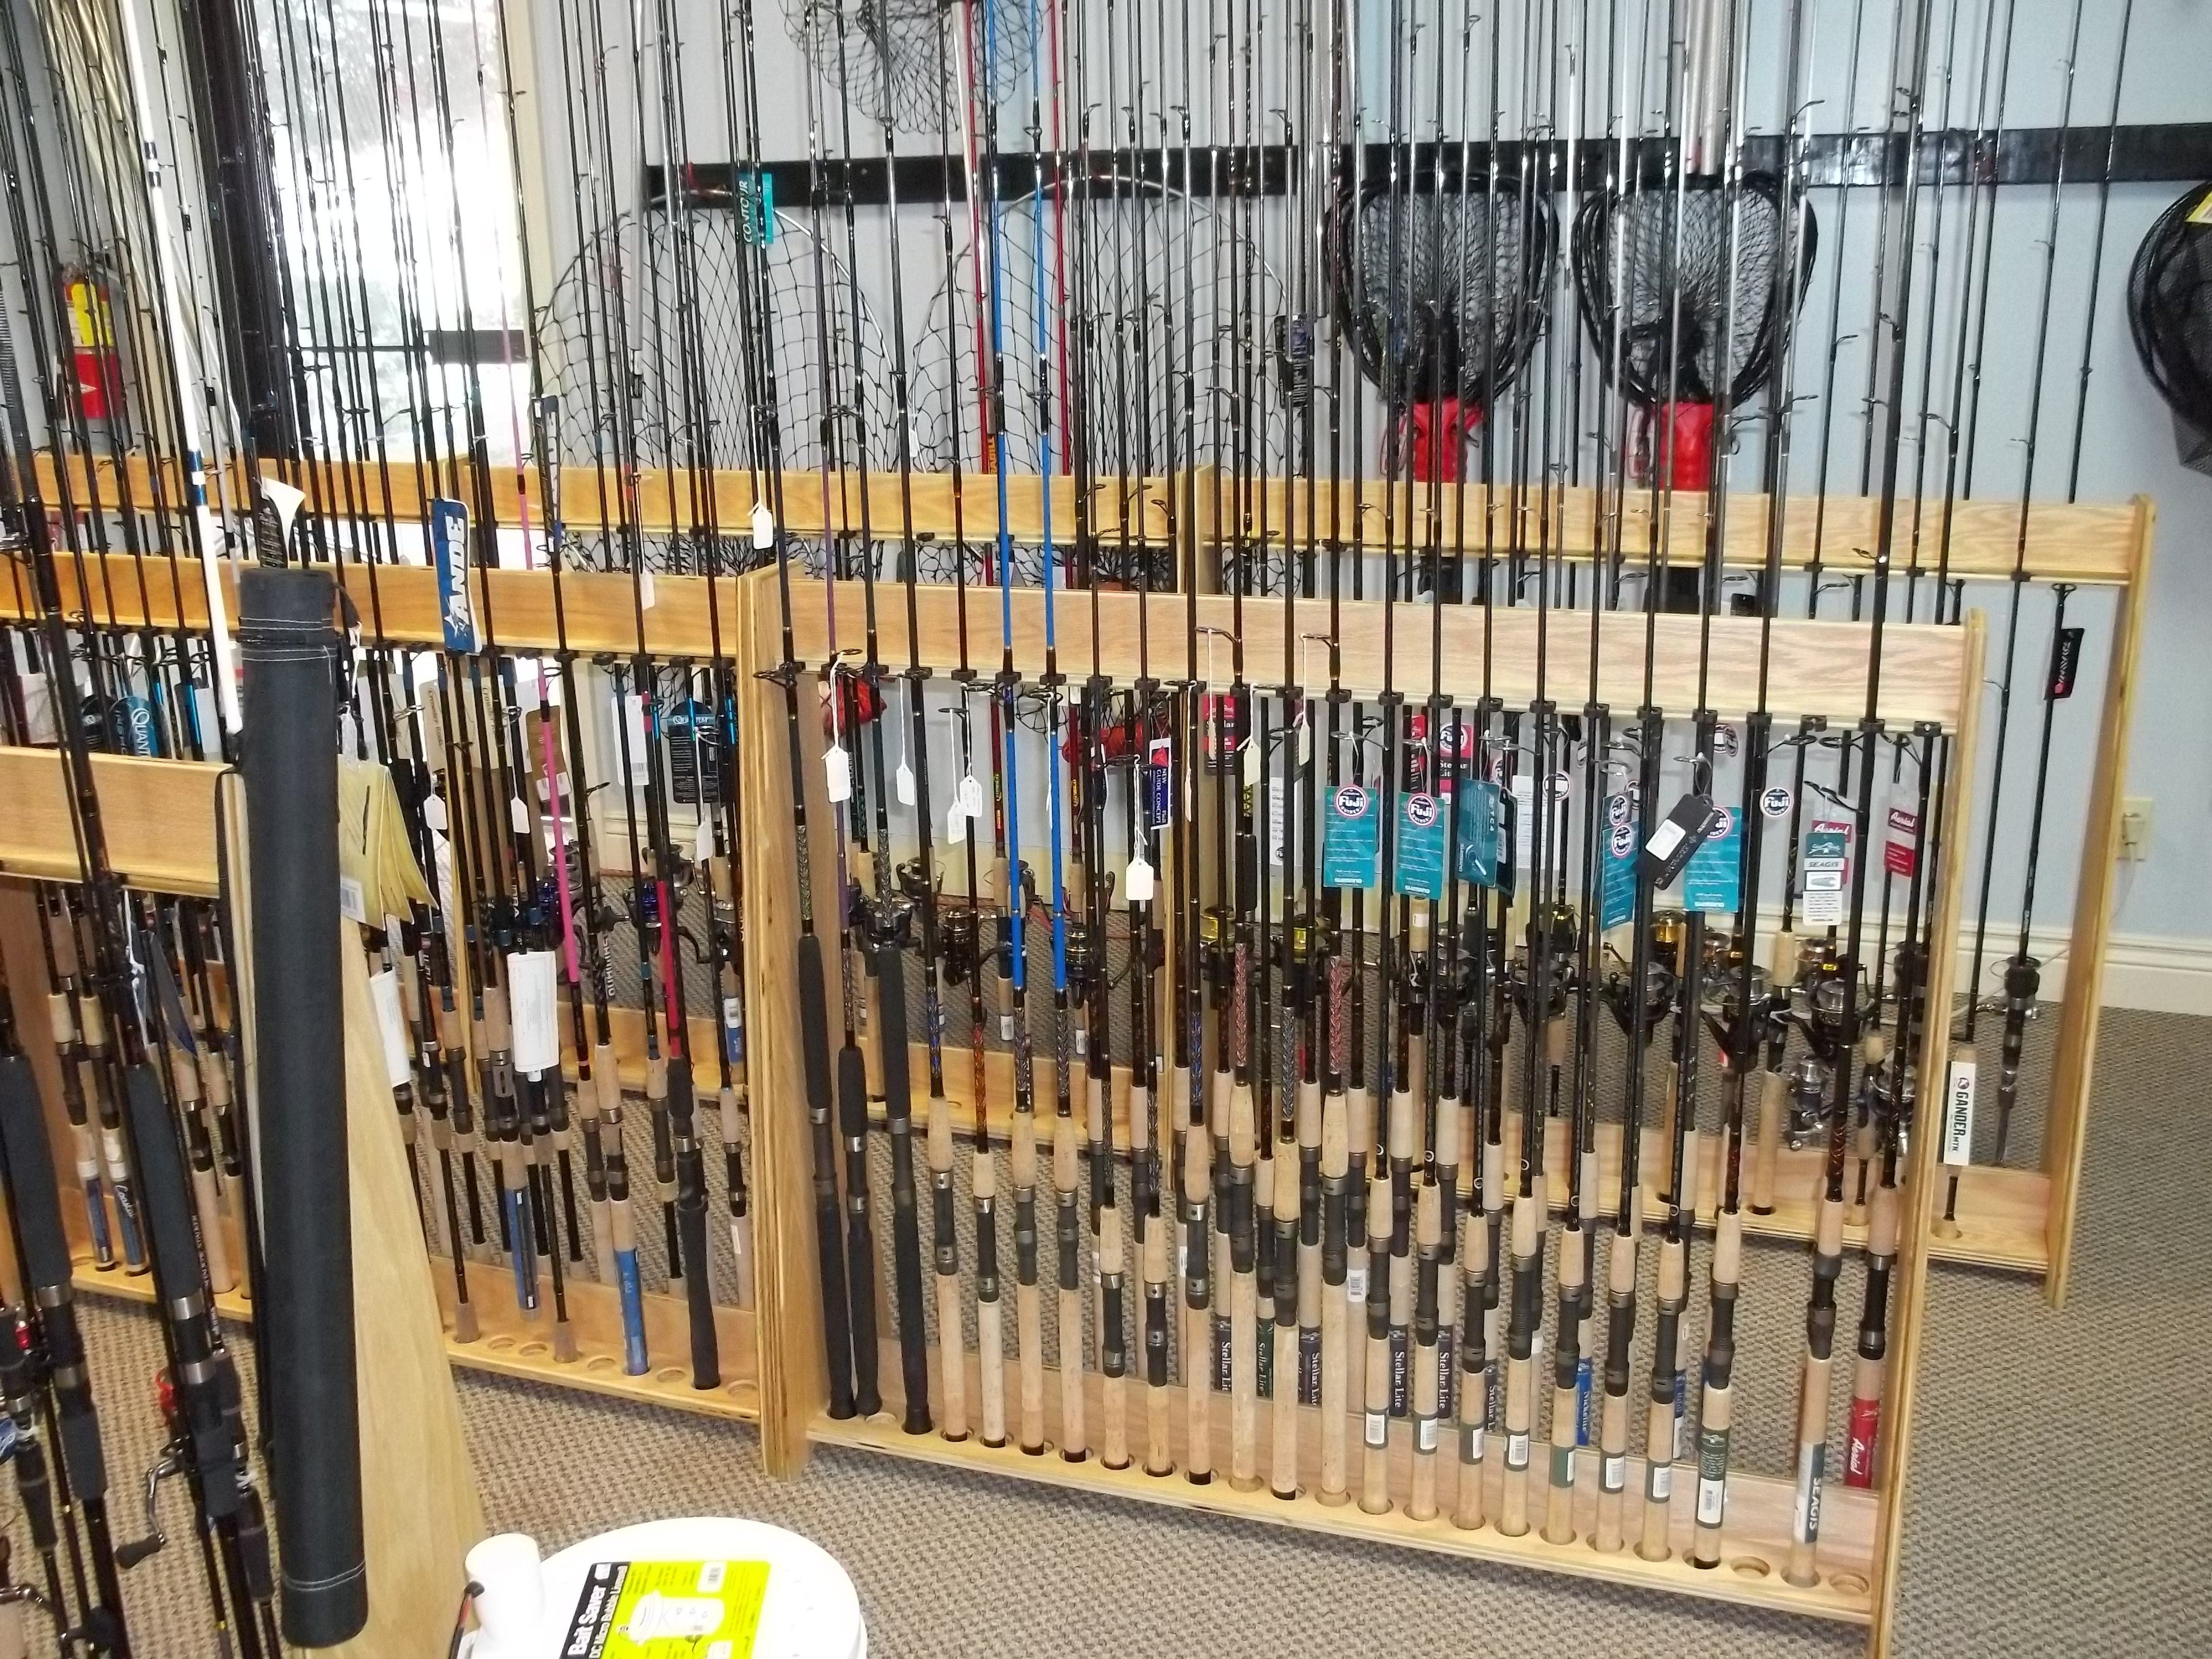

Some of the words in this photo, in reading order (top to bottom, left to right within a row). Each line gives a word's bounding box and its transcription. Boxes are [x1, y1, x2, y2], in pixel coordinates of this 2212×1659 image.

[445, 516, 469, 625] ANDE
[131, 707, 151, 756] QUANT
[1339, 795, 1363, 807] Fuji
[1410, 803, 1433, 817] Fuji
[1612, 803, 1626, 819] Fuji
[1763, 796, 1790, 807] Fuji
[1890, 811, 1915, 828] Aerial
[1614, 833, 1631, 848] Fuji
[603, 937, 615, 997] SHIMANO
[1954, 1091, 1969, 1136] GANDER
[1222, 1341, 1231, 1375] Stellar
[1258, 1342, 1266, 1373] Stellar
[1312, 1352, 1320, 1387] Stellar
[1395, 1351, 1405, 1386] Stellar
[1439, 1352, 1449, 1386] Stellar
[1222, 1377, 1231, 1391] Lit
[1395, 1387, 1405, 1408] Lite
[1439, 1389, 1449, 1409] Lite
[1488, 1385, 1497, 1424] Stellar
[1850, 1437, 1865, 1475] Aerial
[1809, 1477, 1822, 1531] SEAGIS
[578, 1584, 607, 1624] Saver
[567, 1625, 594, 1655] Bait
[589, 1644, 604, 1658] DC
[600, 1594, 619, 1622] Bubble
